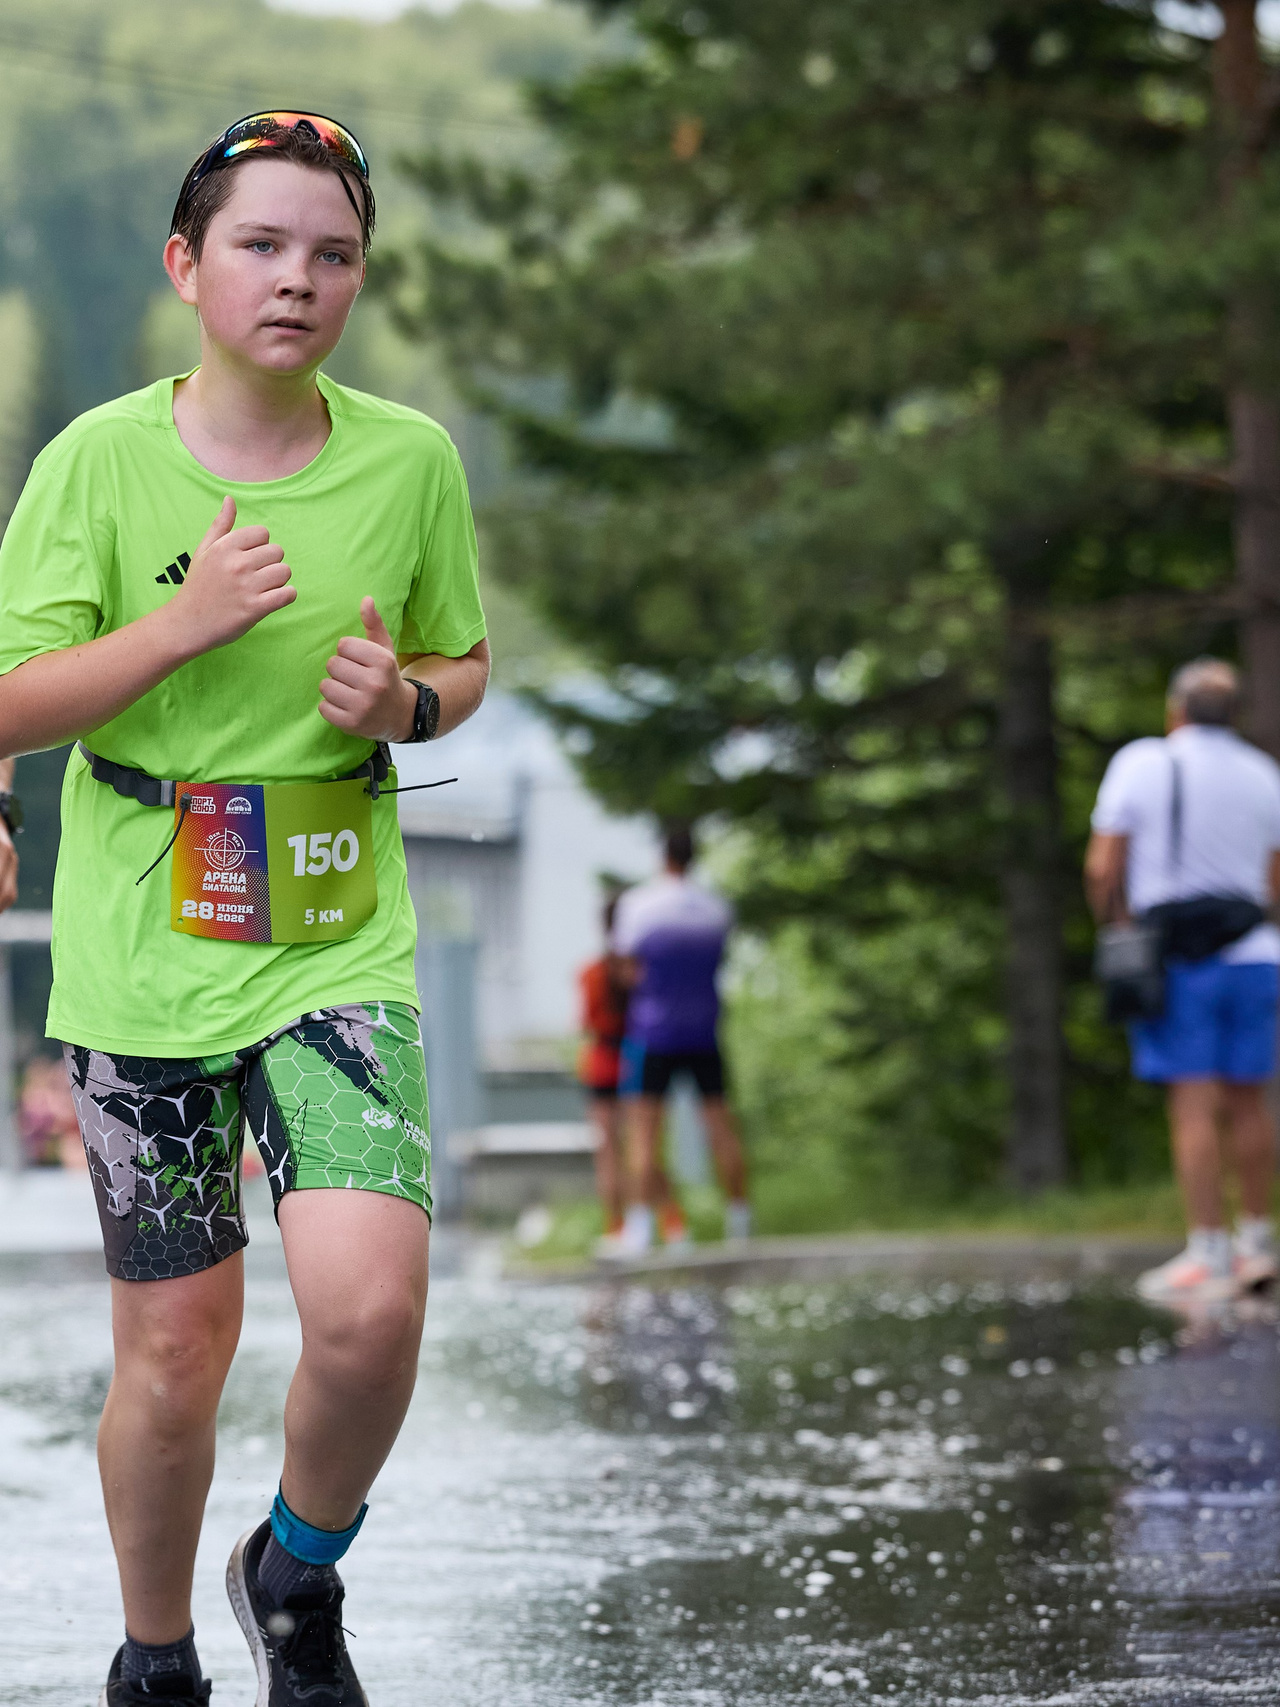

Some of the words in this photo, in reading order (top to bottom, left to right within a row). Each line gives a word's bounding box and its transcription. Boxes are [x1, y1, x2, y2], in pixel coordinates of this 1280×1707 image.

[191, 804, 215, 813] СОЮЗ
[287, 829, 360, 877] 150
[203, 871, 247, 885] АРЕНА
[202, 883, 247, 894] БИАТЛОНА
[181, 899, 215, 920] 28
[304, 908, 315, 925] 5
[216, 913, 246, 923] 2026
